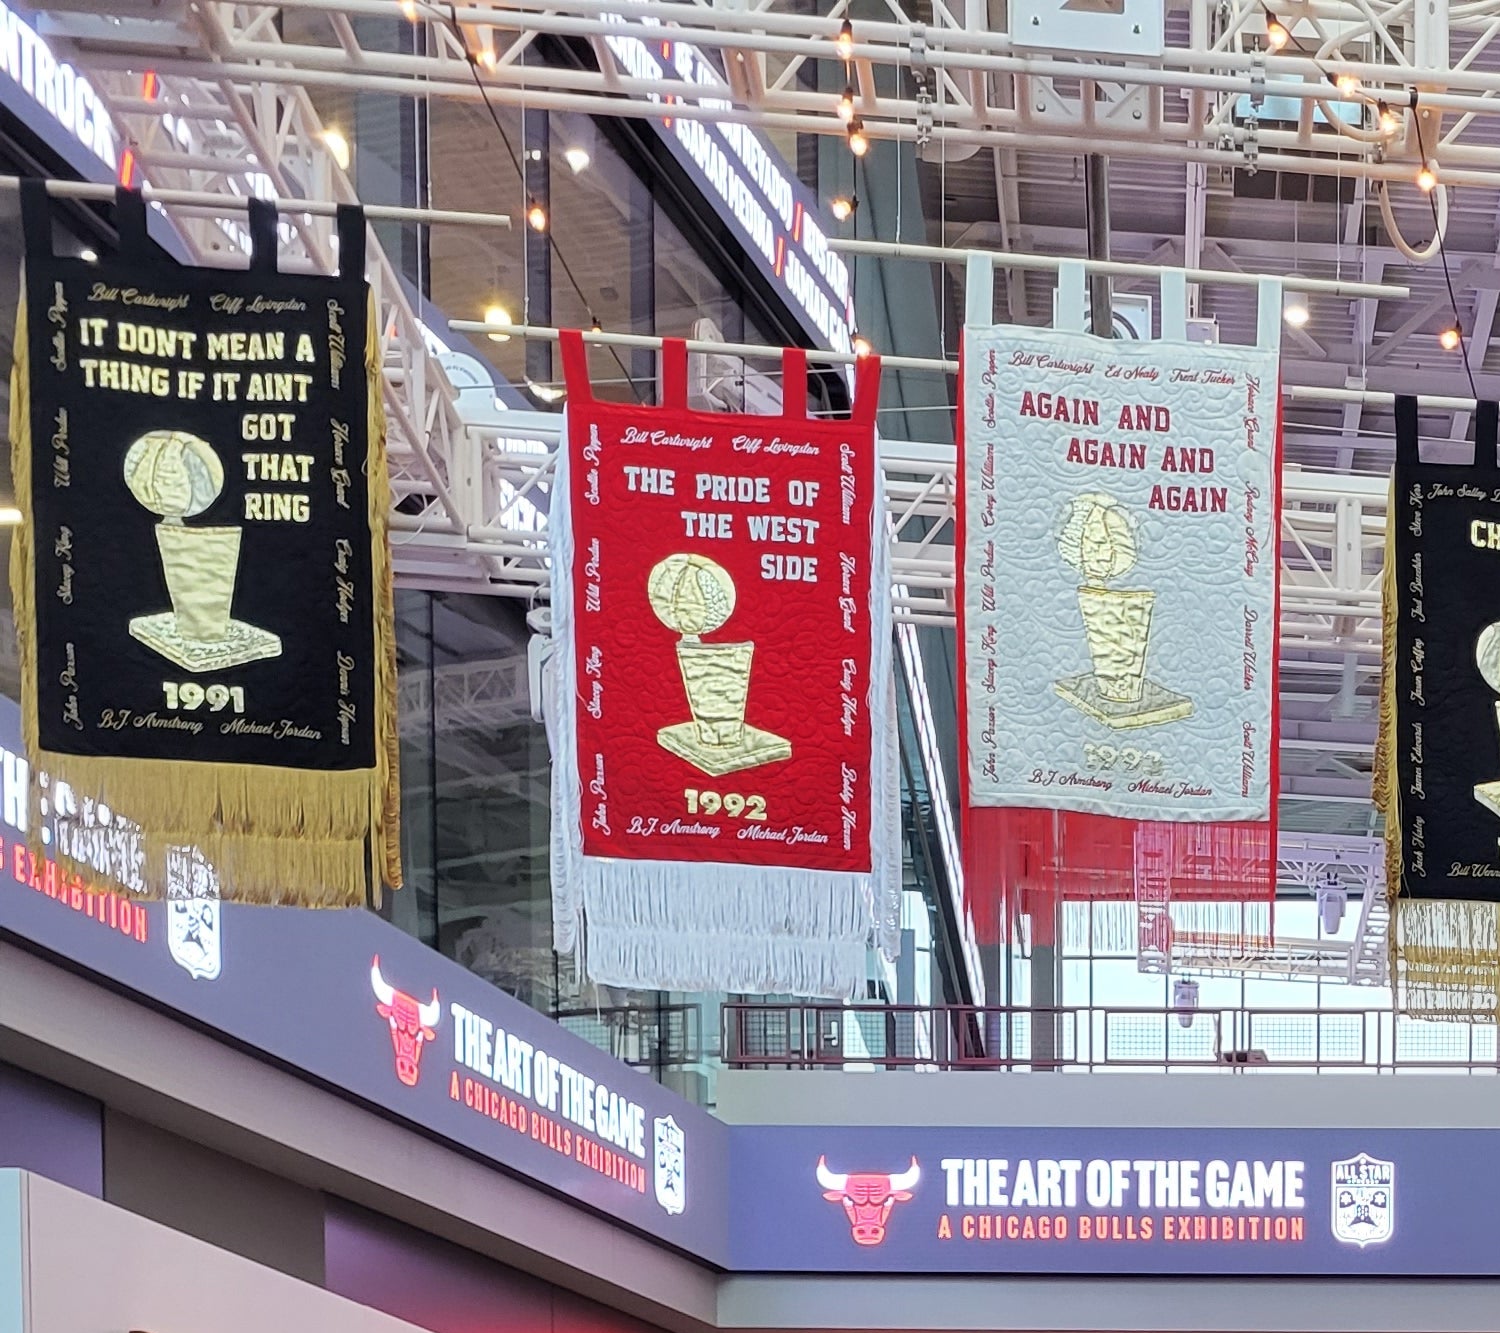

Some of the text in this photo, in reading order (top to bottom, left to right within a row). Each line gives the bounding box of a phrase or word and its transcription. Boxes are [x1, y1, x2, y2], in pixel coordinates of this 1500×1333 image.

[88, 282, 190, 311] Bill Cartwright
[209, 294, 306, 312] Cliff Levingston
[80, 318, 315, 362] IT DONT MEAN A
[1008, 351, 1094, 374] Bill Cartwright
[1105, 365, 1159, 381] Ed Nealy
[1170, 368, 1235, 384] Trent Tucker
[80, 360, 312, 402] THING IF IT AINT
[1020, 391, 1170, 432] AGAIN AND
[242, 413, 296, 441] GOT
[621, 426, 713, 449] Bill Cartwright
[732, 436, 819, 455] Cliff Levingston
[1067, 438, 1214, 473] AGAIN AND
[242, 453, 314, 482] THAT
[583, 424, 601, 505] Scottie Pippen
[624, 466, 819, 506] THE PRIDE OF
[1149, 485, 1228, 512] AGAIN
[1427, 483, 1487, 500] John Salley
[244, 493, 310, 522] RING
[681, 512, 819, 544] THE WEST
[761, 554, 818, 582] SIDE
[1243, 605, 1258, 690] Darrell Walker
[162, 682, 245, 713] 1991
[98, 709, 204, 734] B.J. Armstrong
[220, 720, 322, 740] Michael Jordan
[1411, 723, 1425, 799] James Edwards
[1029, 769, 1112, 791] B.J. Armstrong
[1128, 780, 1212, 796] Michael Jordan
[685, 789, 767, 820] 1992
[626, 816, 720, 838] B.J. Armstrong
[737, 825, 828, 844] Michael Jordan
[1448, 862, 1471, 877] Bill
[451, 1002, 646, 1160] THE ART OF THE GAME
[450, 1071, 460, 1101] A
[465, 1080, 528, 1135] CHICAGO
[531, 1111, 571, 1156] BULLS
[576, 1135, 645, 1194] EXHIBITION
[941, 1158, 1305, 1208] THE ART OF THE GAME
[1336, 1165, 1390, 1180] ALL STAR
[938, 1214, 1304, 1241] A CHICAGO BULLS EXHIBITION
